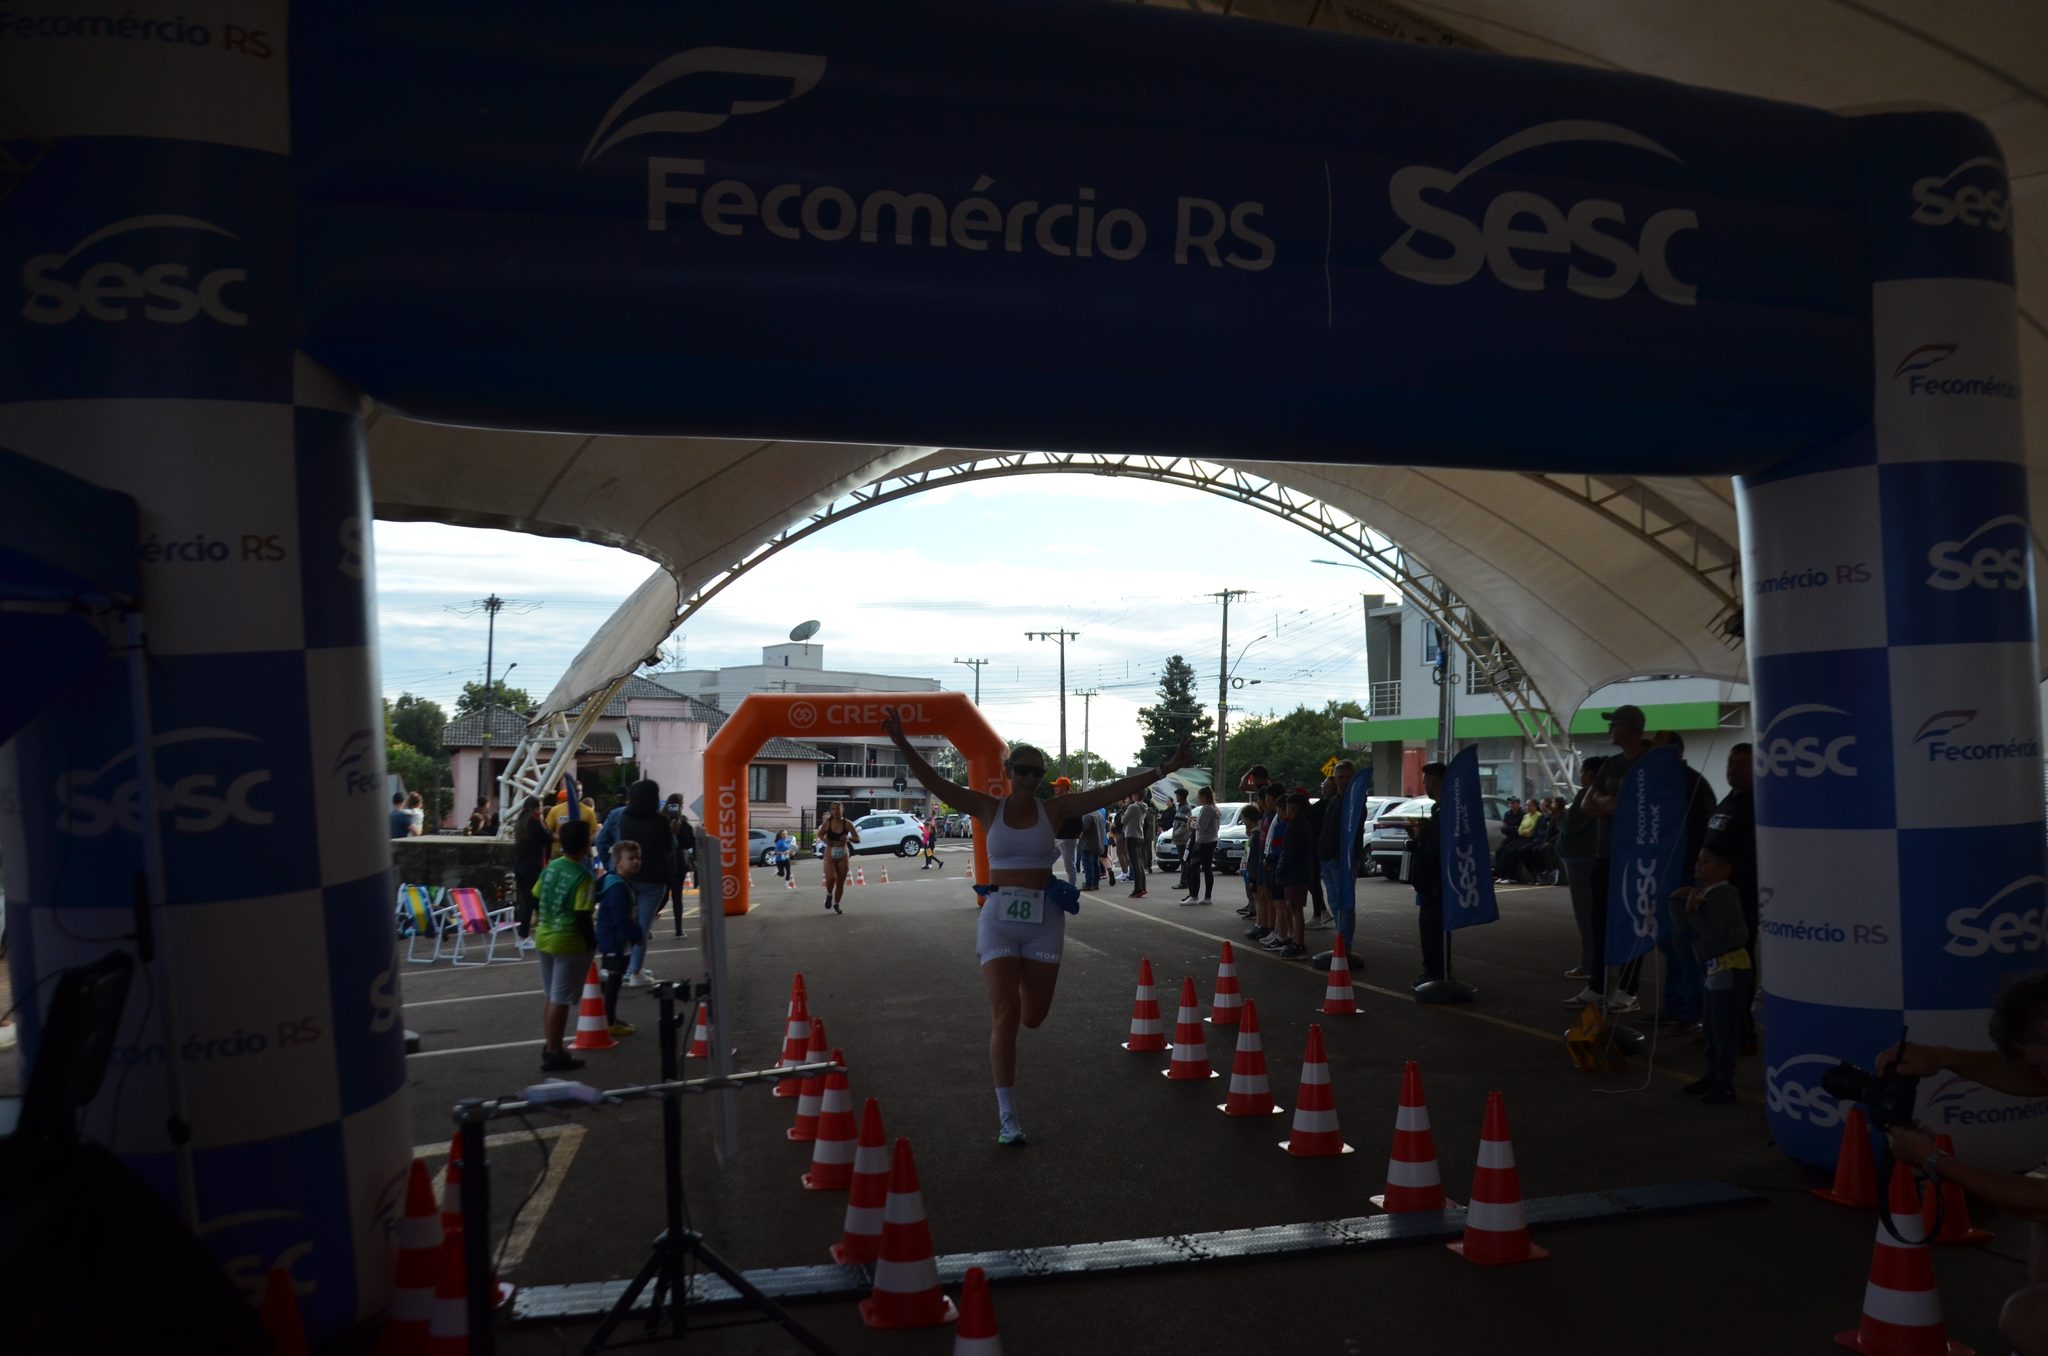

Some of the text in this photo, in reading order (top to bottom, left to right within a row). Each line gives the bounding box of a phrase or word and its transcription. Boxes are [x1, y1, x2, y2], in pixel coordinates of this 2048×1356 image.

[0, 8, 274, 60] Fecomércio RS
[647, 155, 1277, 272] Fecomércio RS
[1910, 174, 2010, 234] Ses
[1379, 164, 1700, 307] Sesc
[20, 250, 250, 328] Sesc
[138, 533, 287, 564] ércio RS
[1836, 562, 1872, 585] RS
[1925, 540, 2033, 592] Ses
[825, 702, 932, 726] CRESOL
[54, 767, 275, 838] Sesc
[719, 778, 737, 868] CRESOL
[1456, 844, 1480, 909] Sesc
[1632, 857, 1659, 938] Sesc
[1007, 900, 1032, 920] 48
[1853, 924, 1890, 945] RS
[1942, 903, 2048, 957] Ses
[274, 1018, 322, 1048] RS
[1766, 1065, 1851, 1128] Ses
